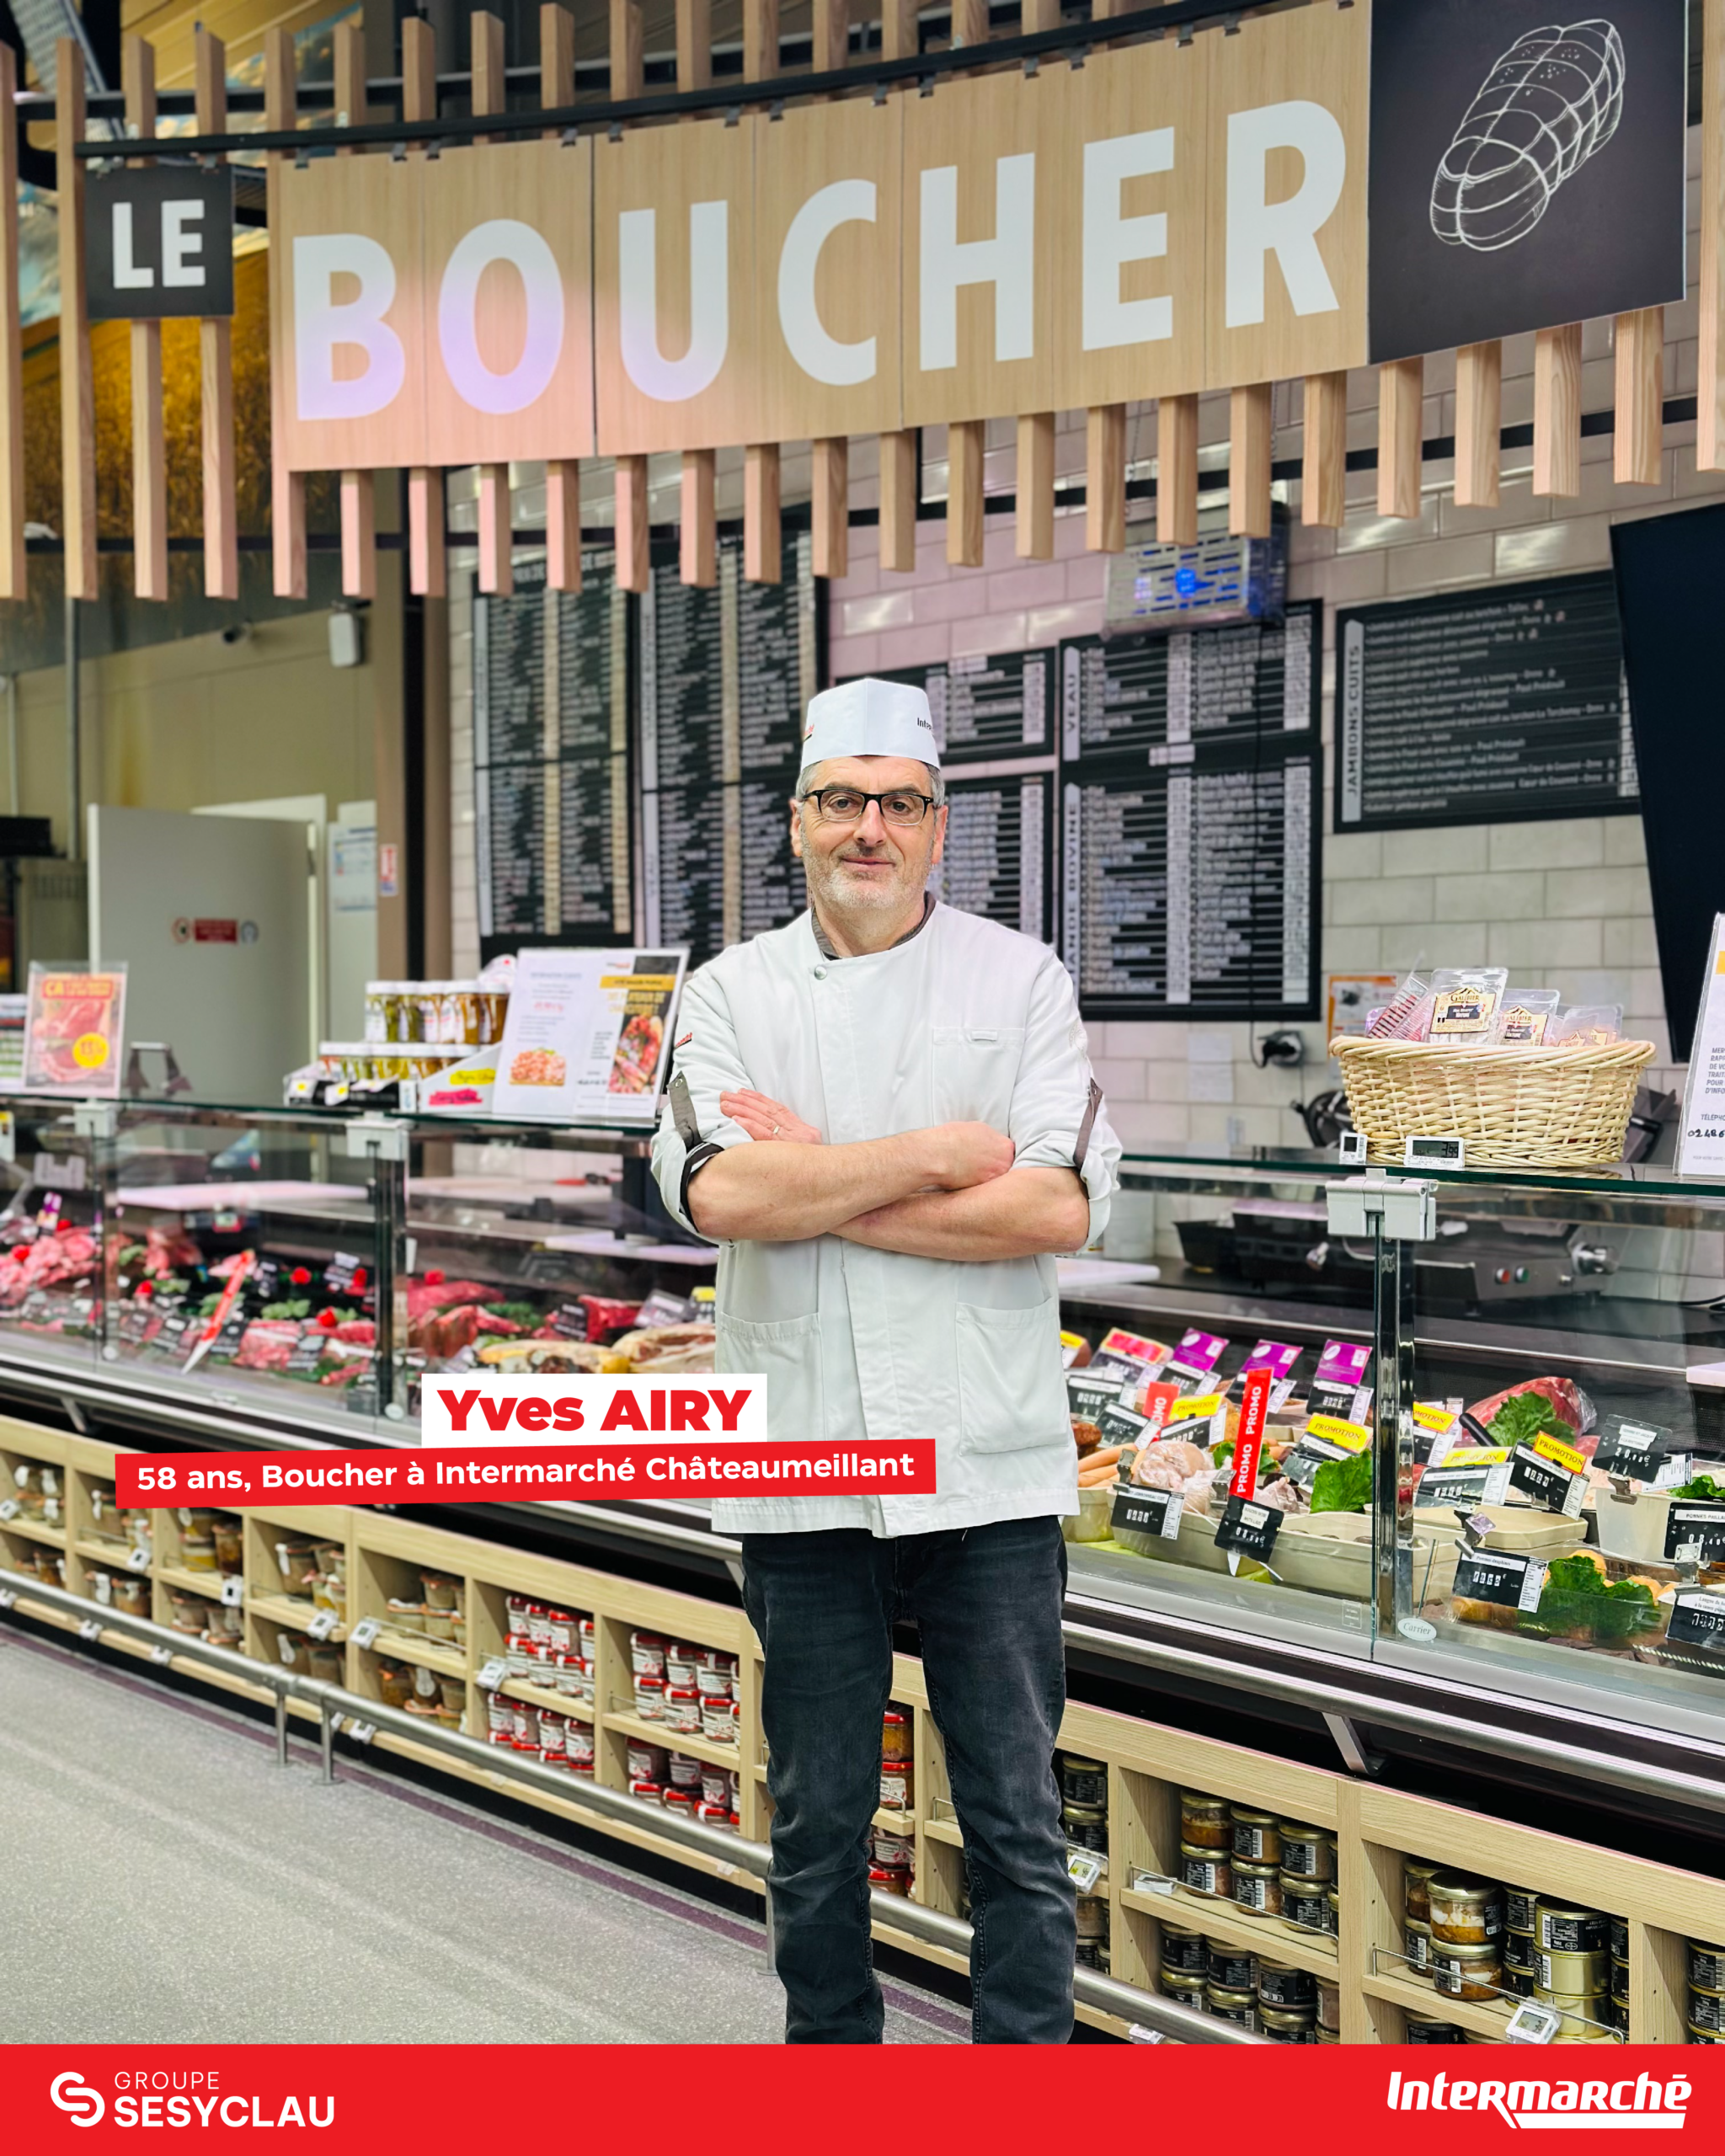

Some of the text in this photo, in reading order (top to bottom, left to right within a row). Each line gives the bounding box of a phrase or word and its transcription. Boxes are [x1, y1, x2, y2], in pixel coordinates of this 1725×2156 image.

[114, 200, 205, 288] LE
[293, 100, 1345, 420] BOUCHER
[1066, 673, 1076, 733] VEAU
[1347, 645, 1359, 798] JAMBONS CUITS
[1067, 803, 1079, 984] IANDE BOVINE
[1151, 1396, 1168, 1425] OMO
[1245, 1386, 1263, 1435] PROMO
[1314, 1422, 1362, 1440] PROMOTION
[1413, 1410, 1447, 1424] OMOTION
[1236, 1444, 1252, 1493] PROMO
[1539, 1438, 1584, 1466] PROMOTION
[1403, 1622, 1432, 1636] Carrier
